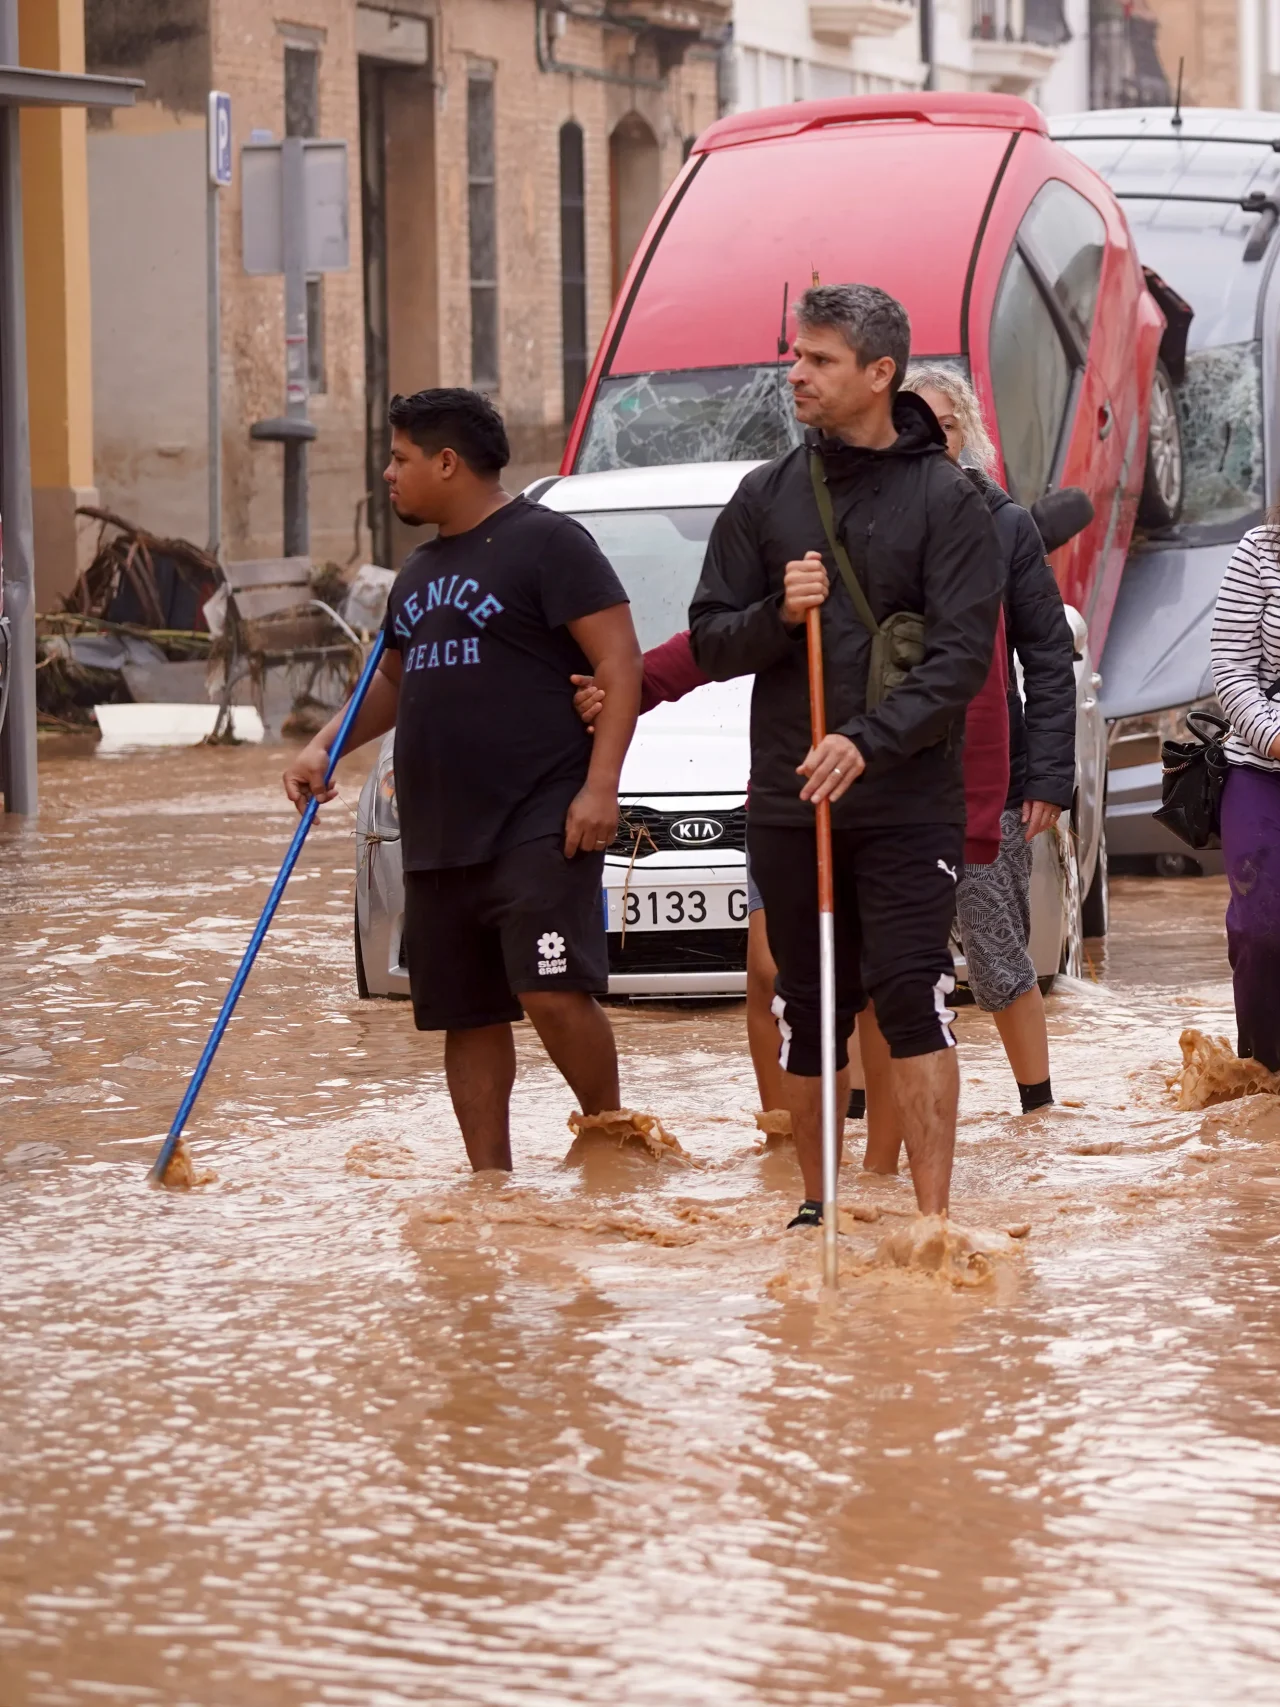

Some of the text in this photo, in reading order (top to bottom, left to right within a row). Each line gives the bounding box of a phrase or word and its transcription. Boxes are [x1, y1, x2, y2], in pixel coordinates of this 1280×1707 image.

[218, 106, 229, 171] P
[394, 574, 505, 639] VENICE
[405, 637, 481, 673] BEACH
[679, 823, 715, 838] KIA
[622, 889, 707, 926] 3133
[537, 958, 567, 968] SLOW
[538, 965, 567, 976] GROW
